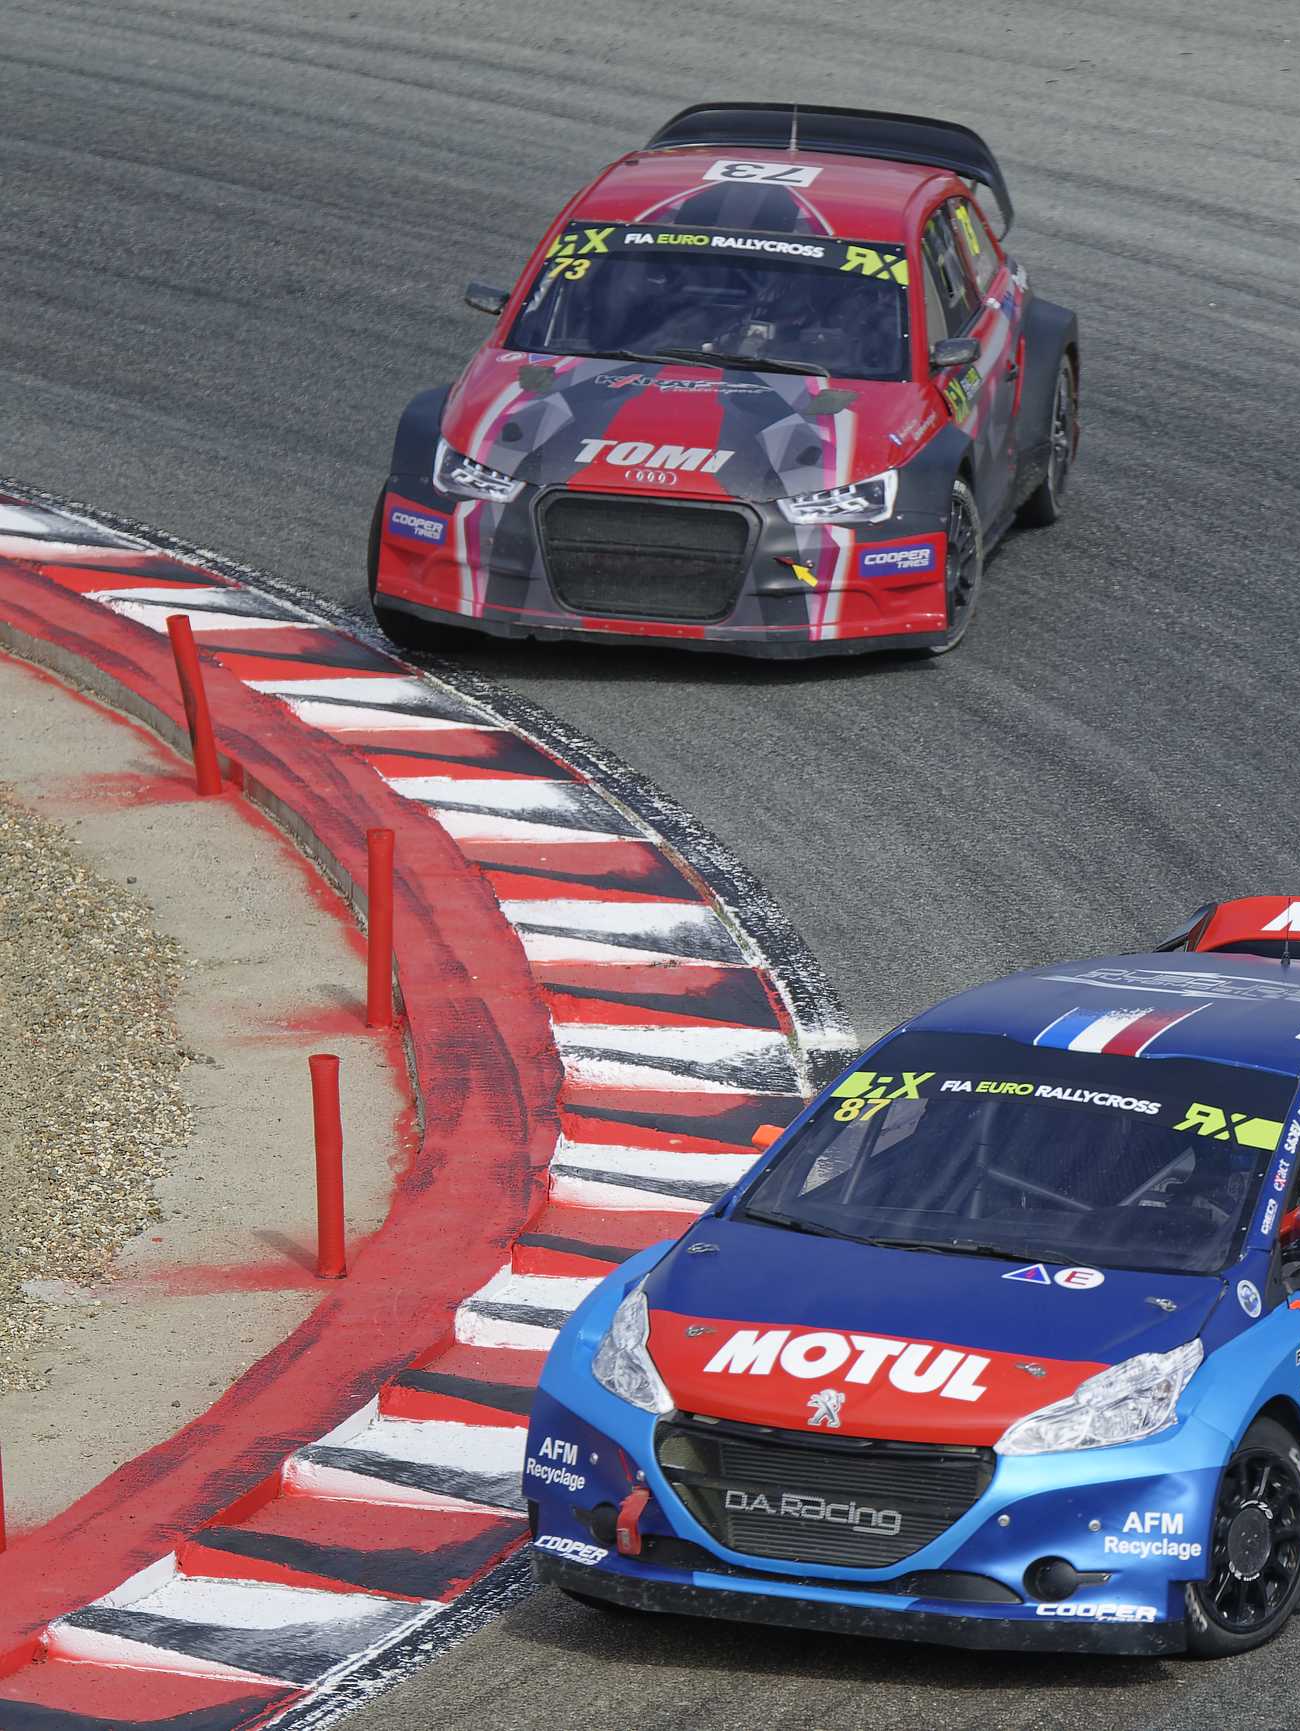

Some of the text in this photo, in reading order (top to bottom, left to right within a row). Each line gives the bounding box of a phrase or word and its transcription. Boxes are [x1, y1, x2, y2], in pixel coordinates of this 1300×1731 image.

[624, 233, 825, 258] FIA EURO RALLYCROSS
[549, 258, 592, 281] 73
[574, 438, 736, 473] TOMI
[392, 512, 444, 533] COOPER
[864, 548, 931, 565] COOPER
[833, 1098, 892, 1123] 87
[940, 1080, 1163, 1116] FIA EURO RALLYCROSS
[703, 1329, 991, 1402] MOTUL
[539, 1437, 578, 1465] AFM
[526, 1458, 586, 1491] Recyclage
[1122, 1511, 1184, 1535] AFM
[534, 1535, 609, 1561] COOPER
[1104, 1536, 1202, 1561] Recyclage
[1036, 1602, 1157, 1623] COOPER
